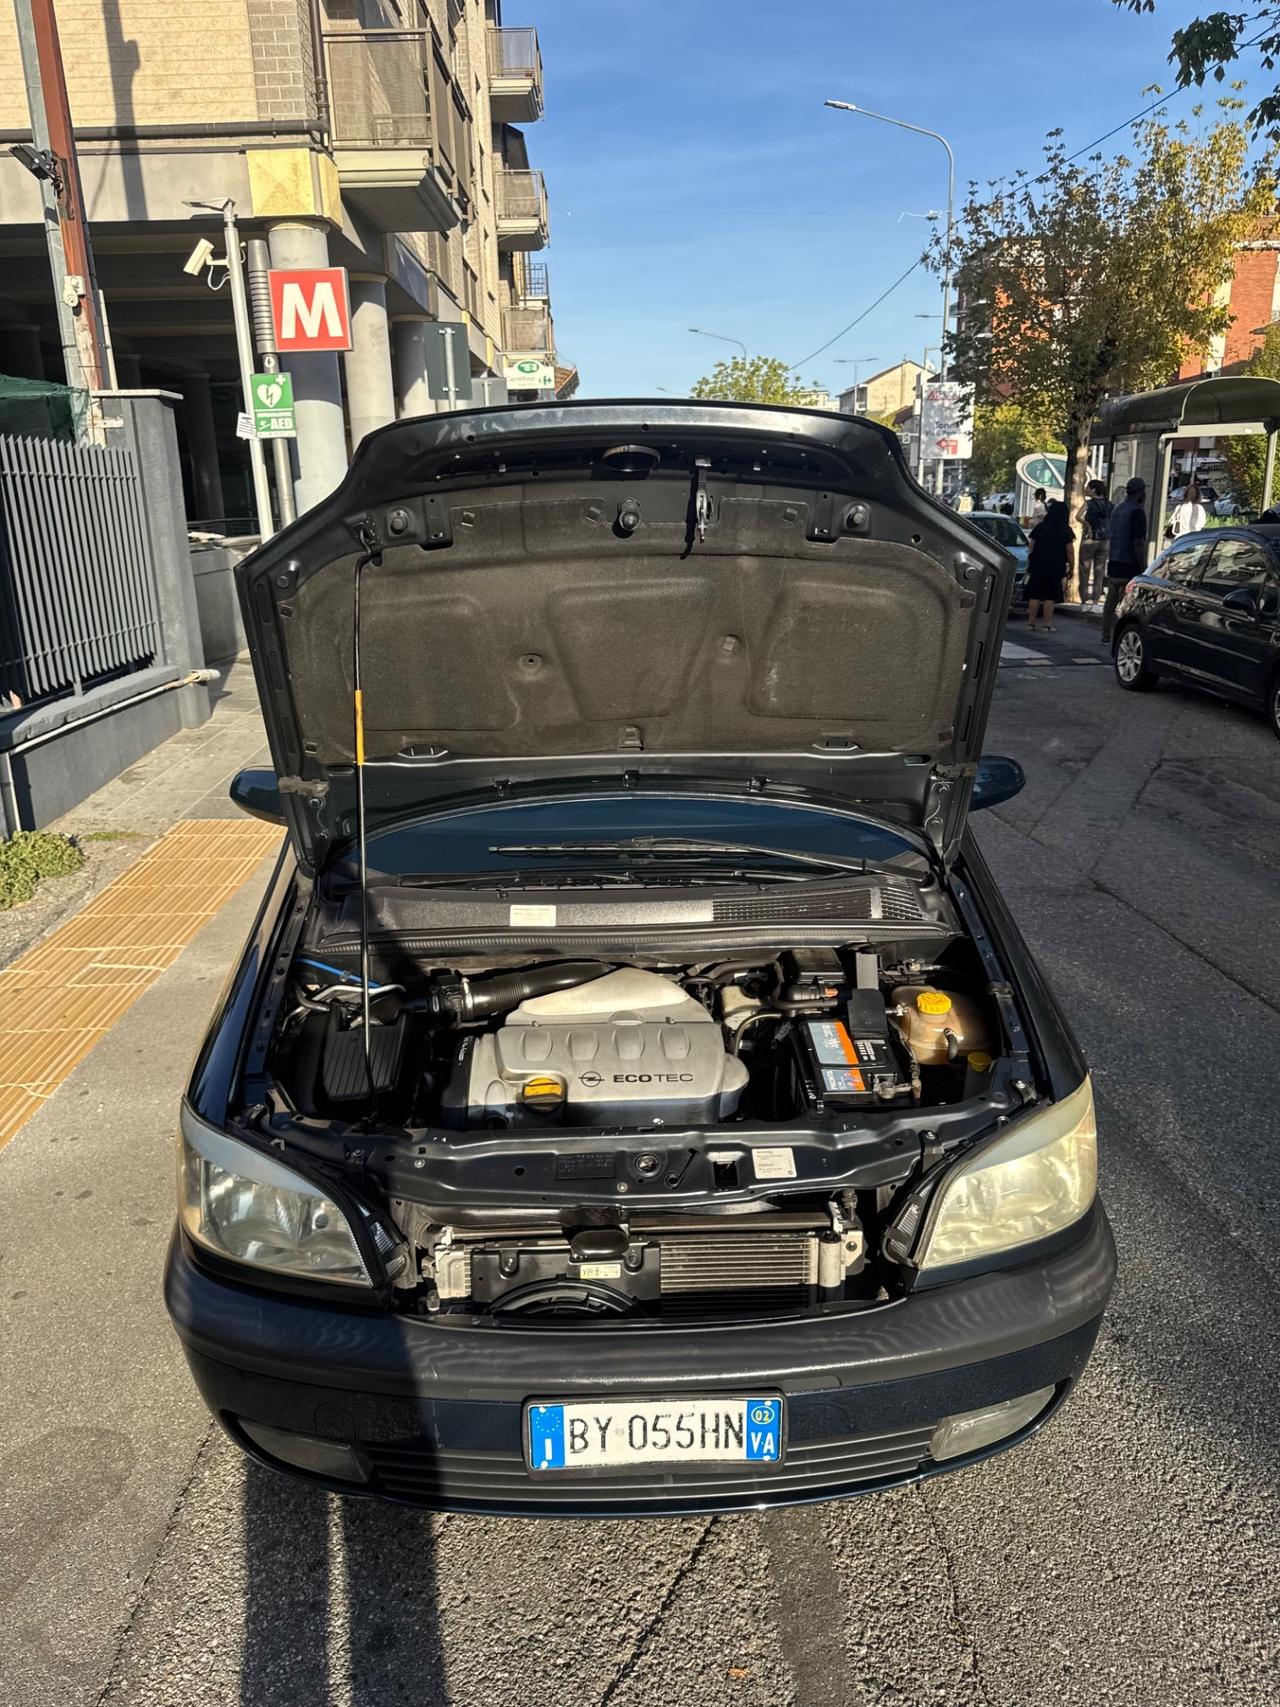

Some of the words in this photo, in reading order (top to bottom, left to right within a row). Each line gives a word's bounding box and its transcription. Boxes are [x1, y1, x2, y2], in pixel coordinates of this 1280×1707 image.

[281, 282, 343, 338] M
[613, 1074, 693, 1082] ECOTEC
[755, 1410, 770, 1421] 02
[569, 1416, 612, 1454] BY
[628, 1412, 744, 1450] 055HN
[751, 1431, 775, 1454] VA
[545, 1438, 553, 1461] I
